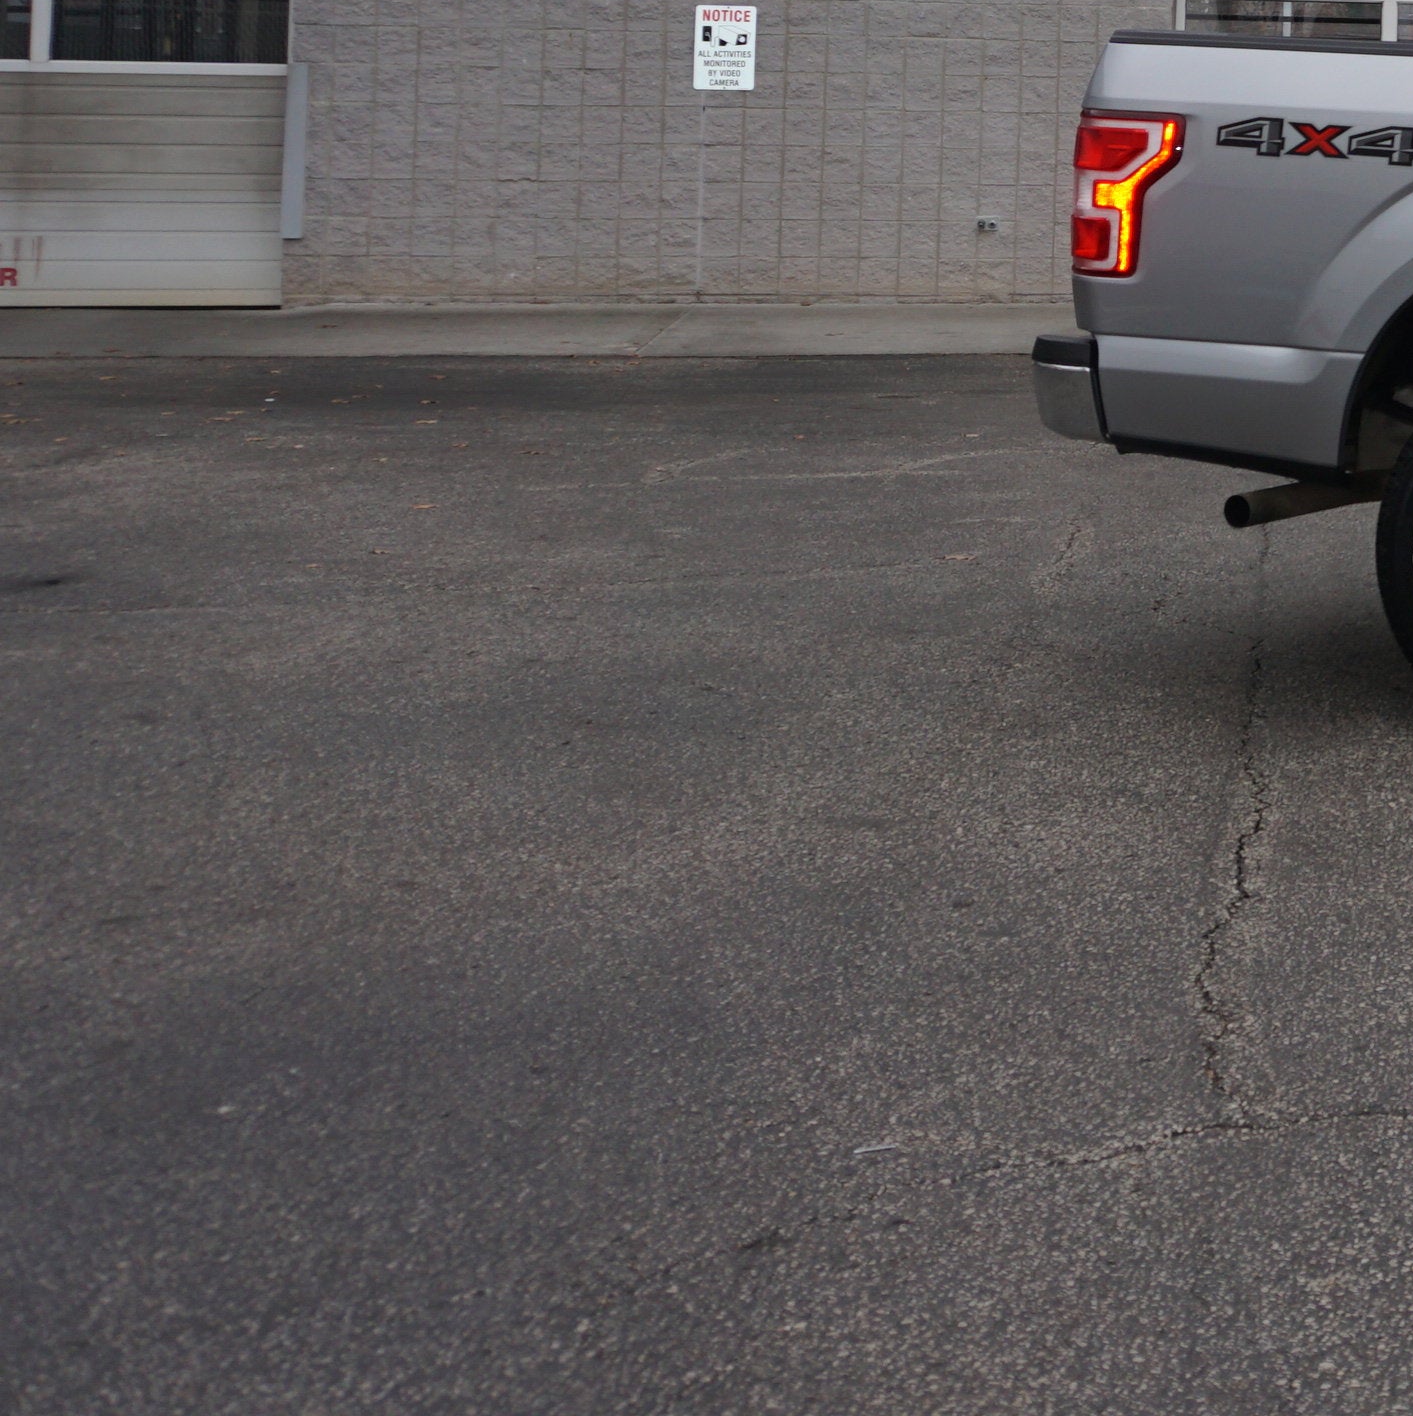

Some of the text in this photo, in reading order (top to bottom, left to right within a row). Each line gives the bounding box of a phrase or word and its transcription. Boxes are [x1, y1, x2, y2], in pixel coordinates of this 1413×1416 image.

[702, 9, 752, 23] NOTICE
[698, 50, 752, 58] ALL ACTIVITIES
[703, 60, 746, 68] MONITORED
[720, 70, 741, 78] VIDEO
[709, 79, 739, 87] CAMERA
